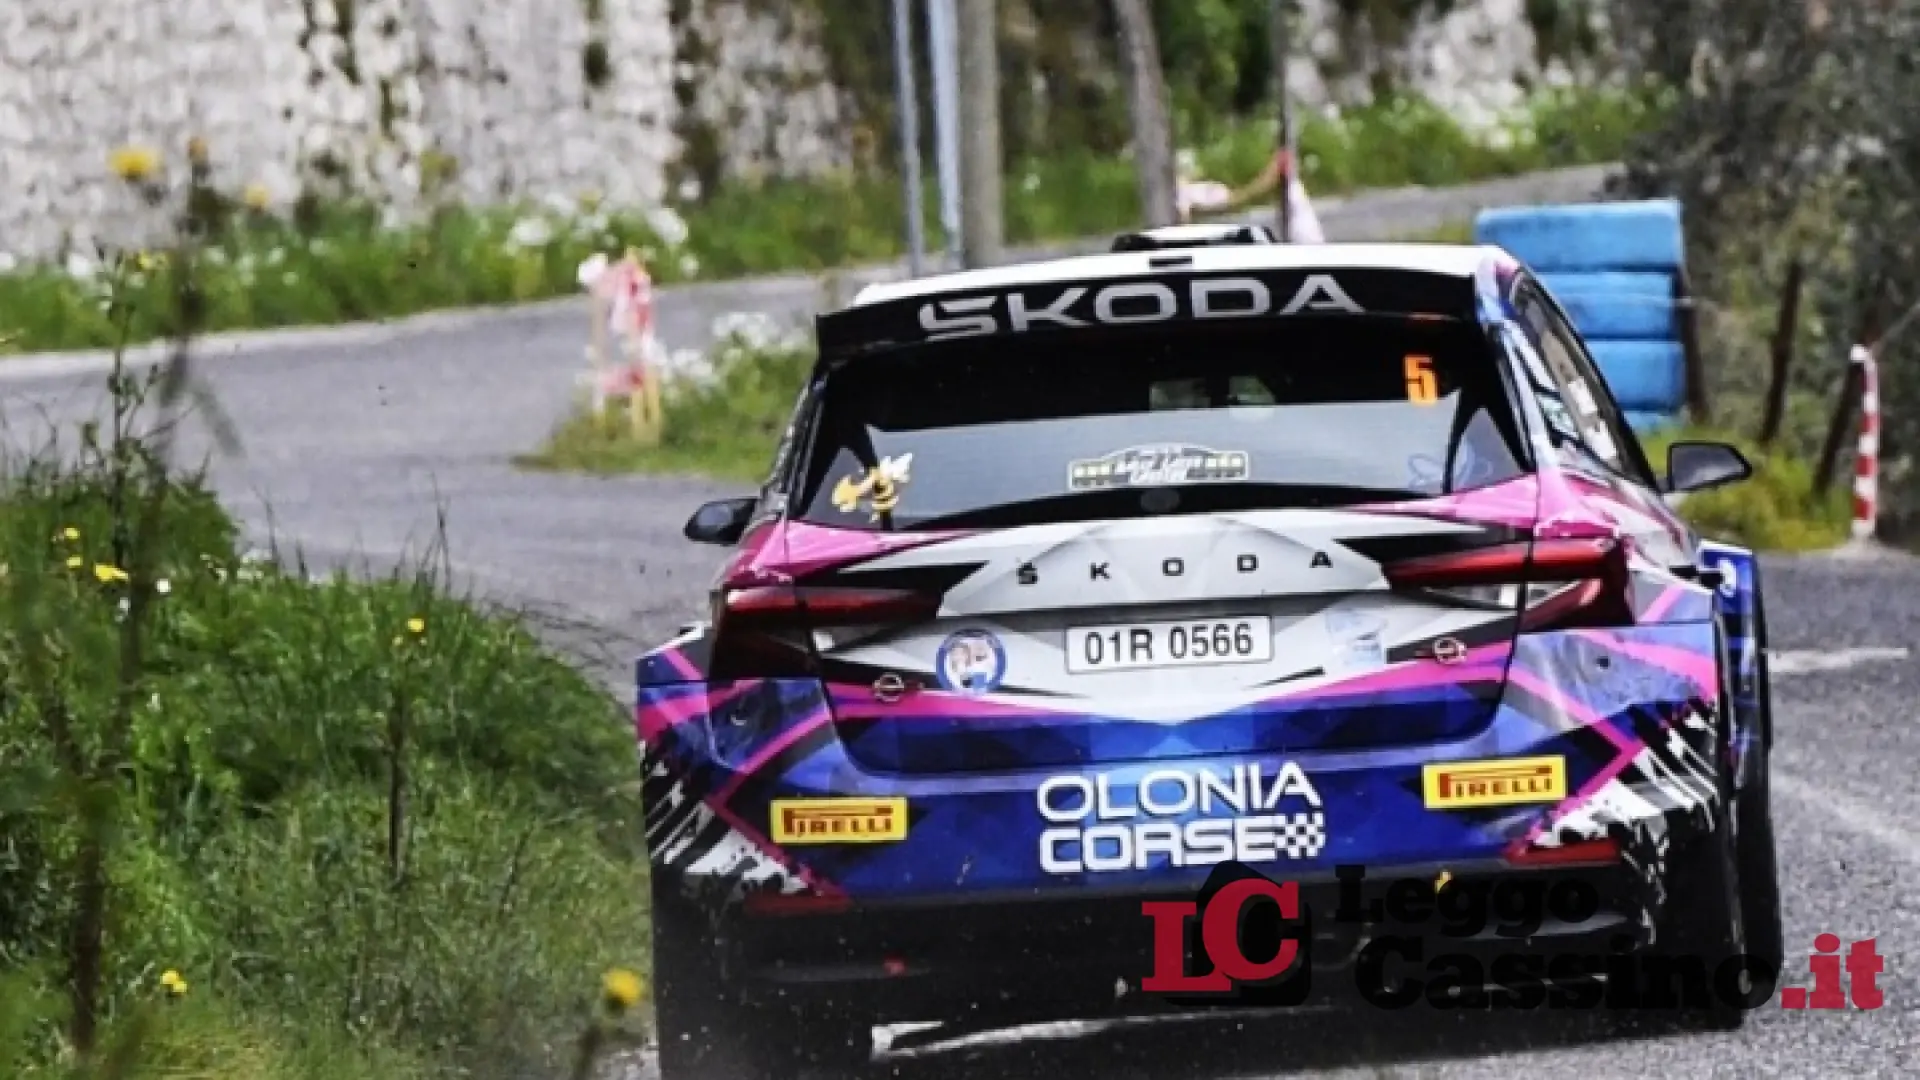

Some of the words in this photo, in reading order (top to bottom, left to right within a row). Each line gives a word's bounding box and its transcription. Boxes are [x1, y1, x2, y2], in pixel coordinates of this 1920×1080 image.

[1404, 355, 1437, 404] 5
[1085, 629, 1153, 664] 01R
[1168, 622, 1252, 659] 0566
[1037, 762, 1321, 823] OLONIA
[1439, 765, 1553, 800] PIRELLI
[781, 805, 894, 836] PIRELLI
[1039, 817, 1277, 874] CORSE
